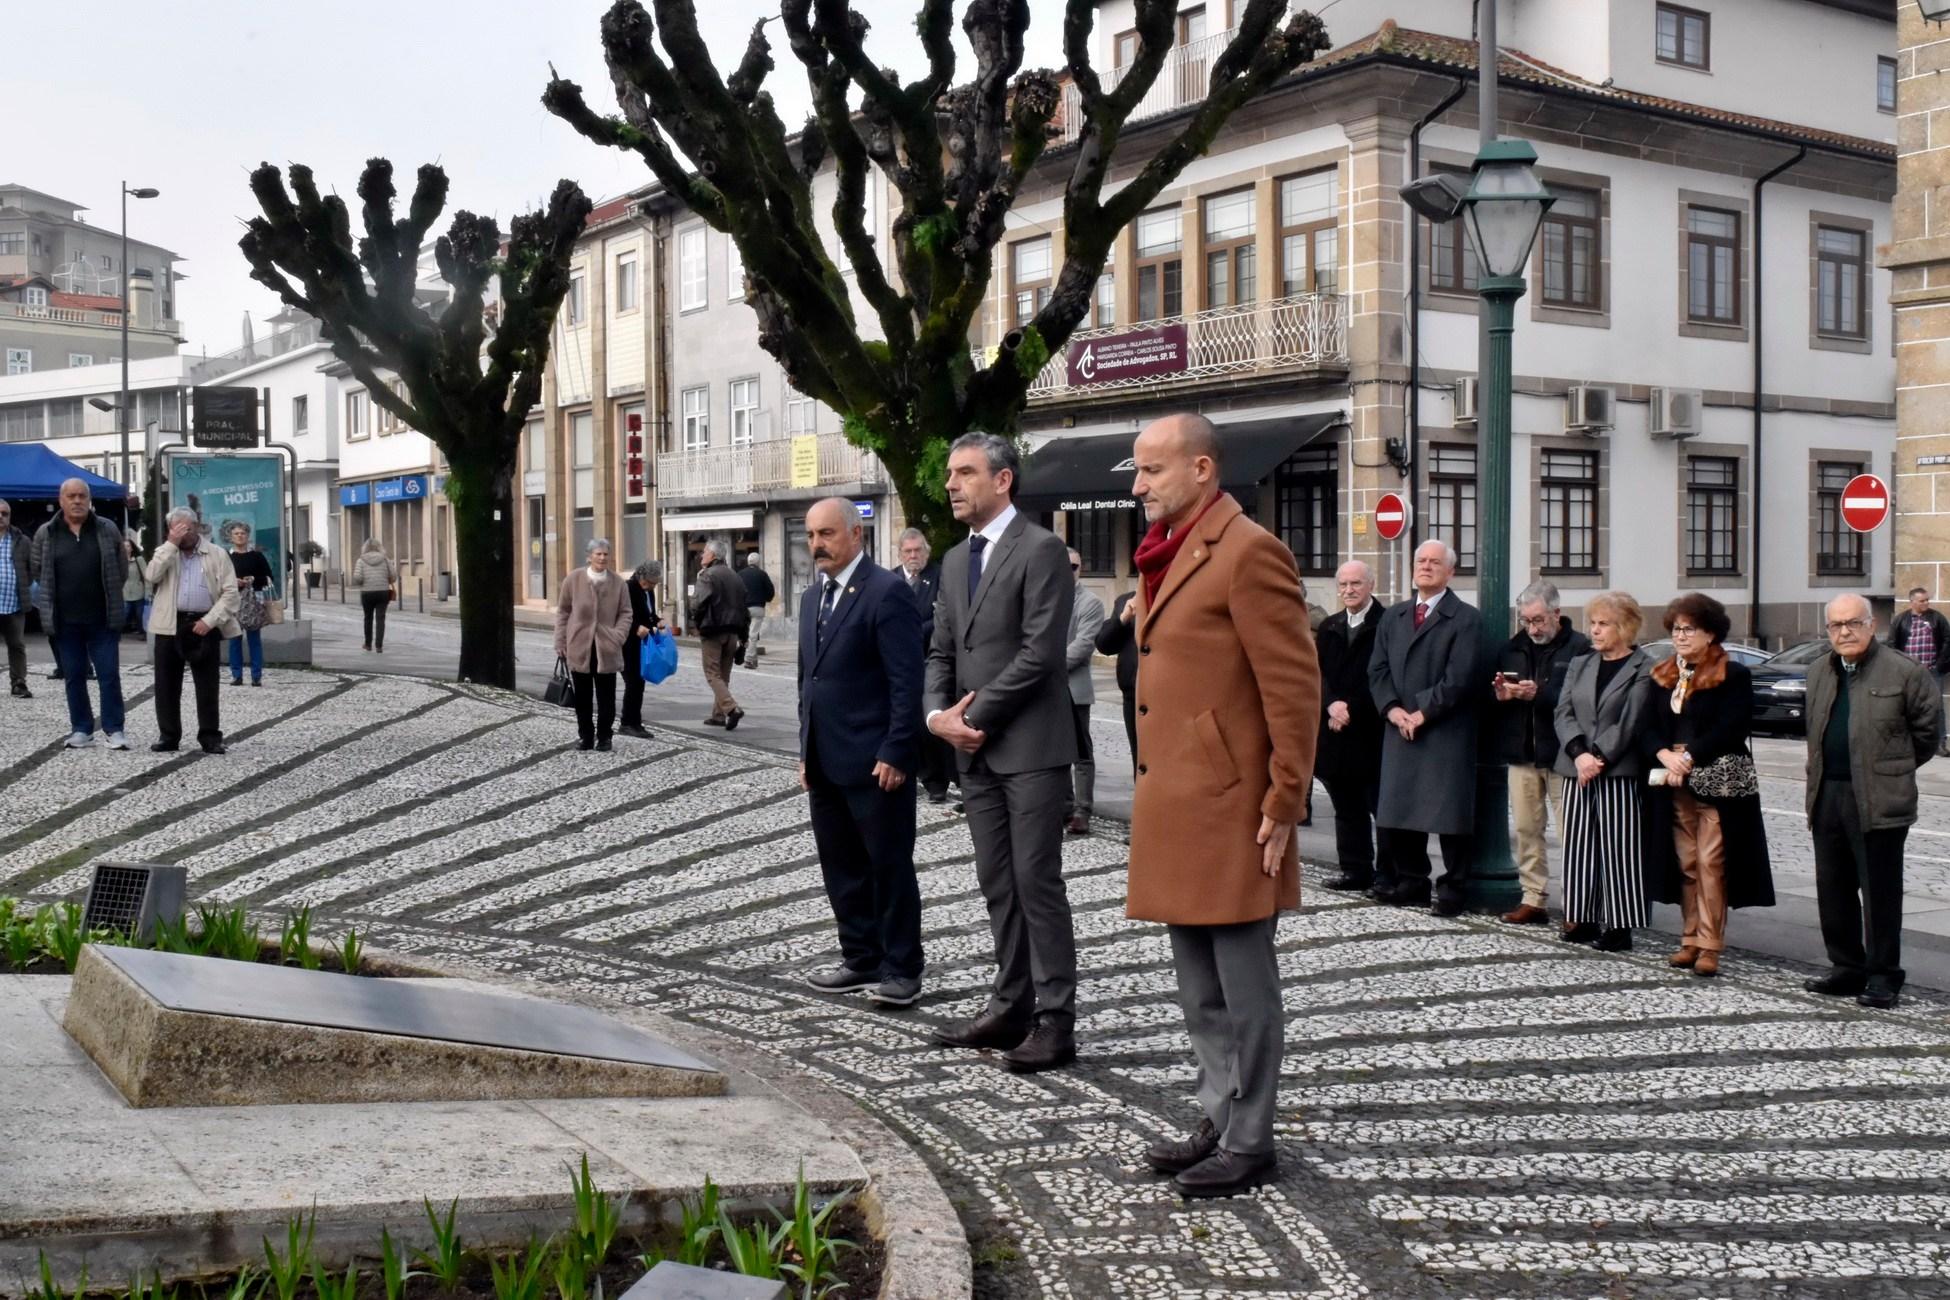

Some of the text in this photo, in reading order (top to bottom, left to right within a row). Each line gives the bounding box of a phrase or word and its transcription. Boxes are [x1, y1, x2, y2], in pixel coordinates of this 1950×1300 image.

[1097, 360, 1122, 370] Sociedade
[1123, 358, 1129, 366] de
[197, 432, 253, 441] MUNICIPAL
[176, 464, 208, 479] ONE
[224, 491, 259, 506] HOJE
[1078, 501, 1092, 510] Leal
[1095, 500, 1116, 509] Dental
